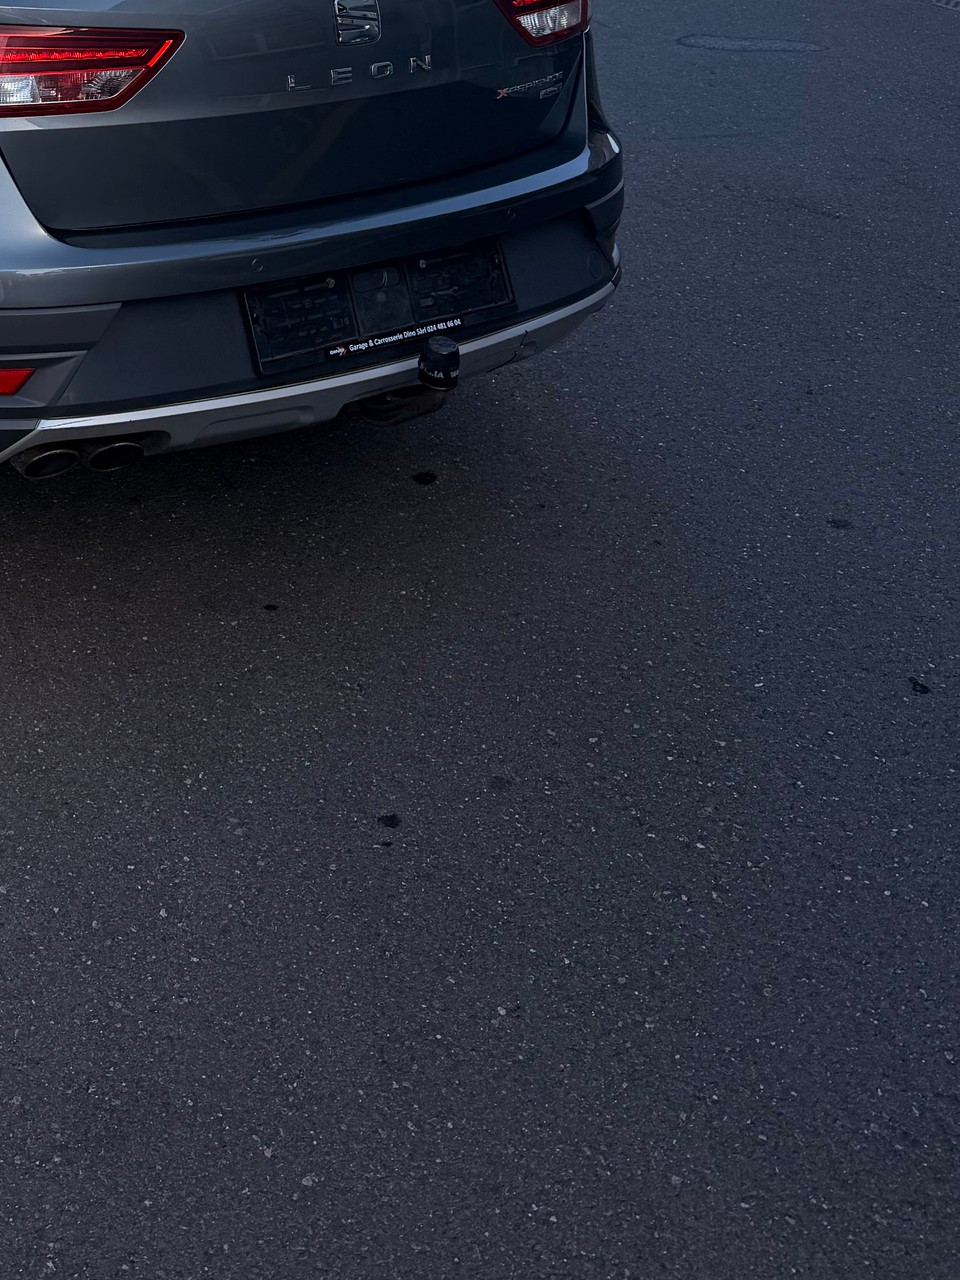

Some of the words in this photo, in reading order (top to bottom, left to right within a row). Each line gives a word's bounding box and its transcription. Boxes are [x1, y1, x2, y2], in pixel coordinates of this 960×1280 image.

[287, 54, 432, 92] LEON
[349, 342, 369, 352] Garage
[374, 333, 404, 346] Carrosserie
[404, 330, 416, 338] Dino
